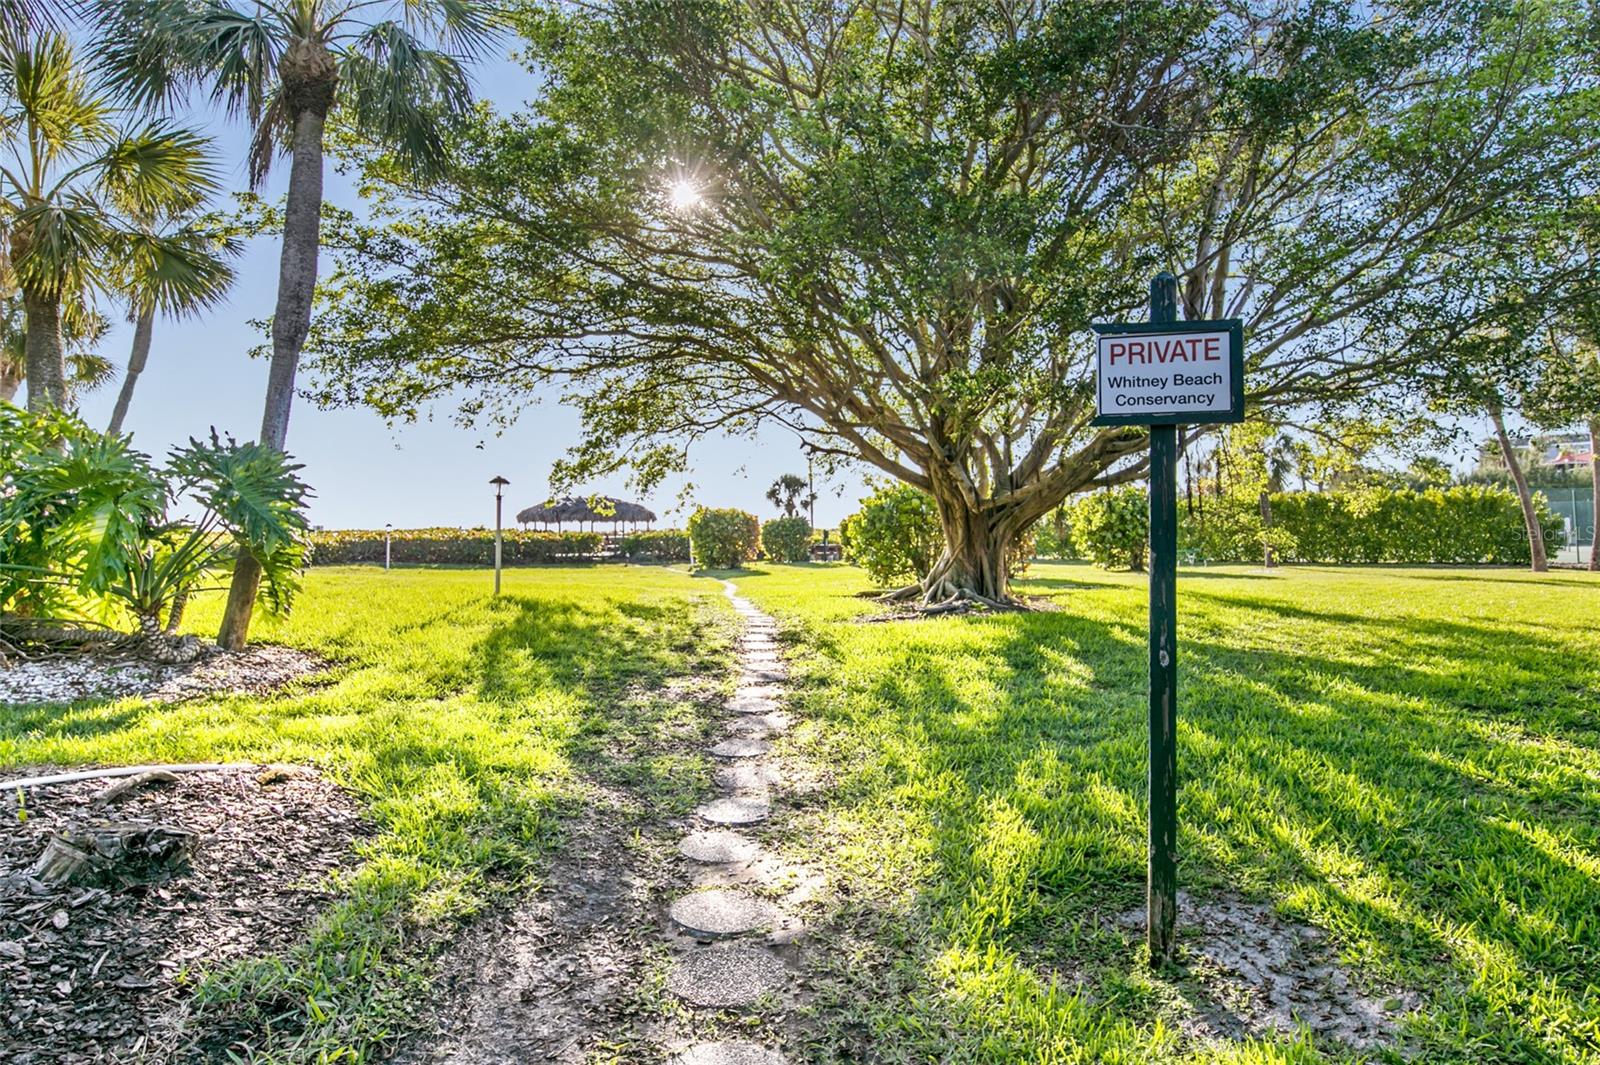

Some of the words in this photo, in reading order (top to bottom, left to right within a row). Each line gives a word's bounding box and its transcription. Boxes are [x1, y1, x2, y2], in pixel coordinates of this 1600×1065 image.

[1110, 338, 1220, 365] PRIVATE
[1108, 376, 1168, 390] Whitney
[1173, 373, 1222, 386] Beach
[1115, 394, 1215, 406] Conservancy
